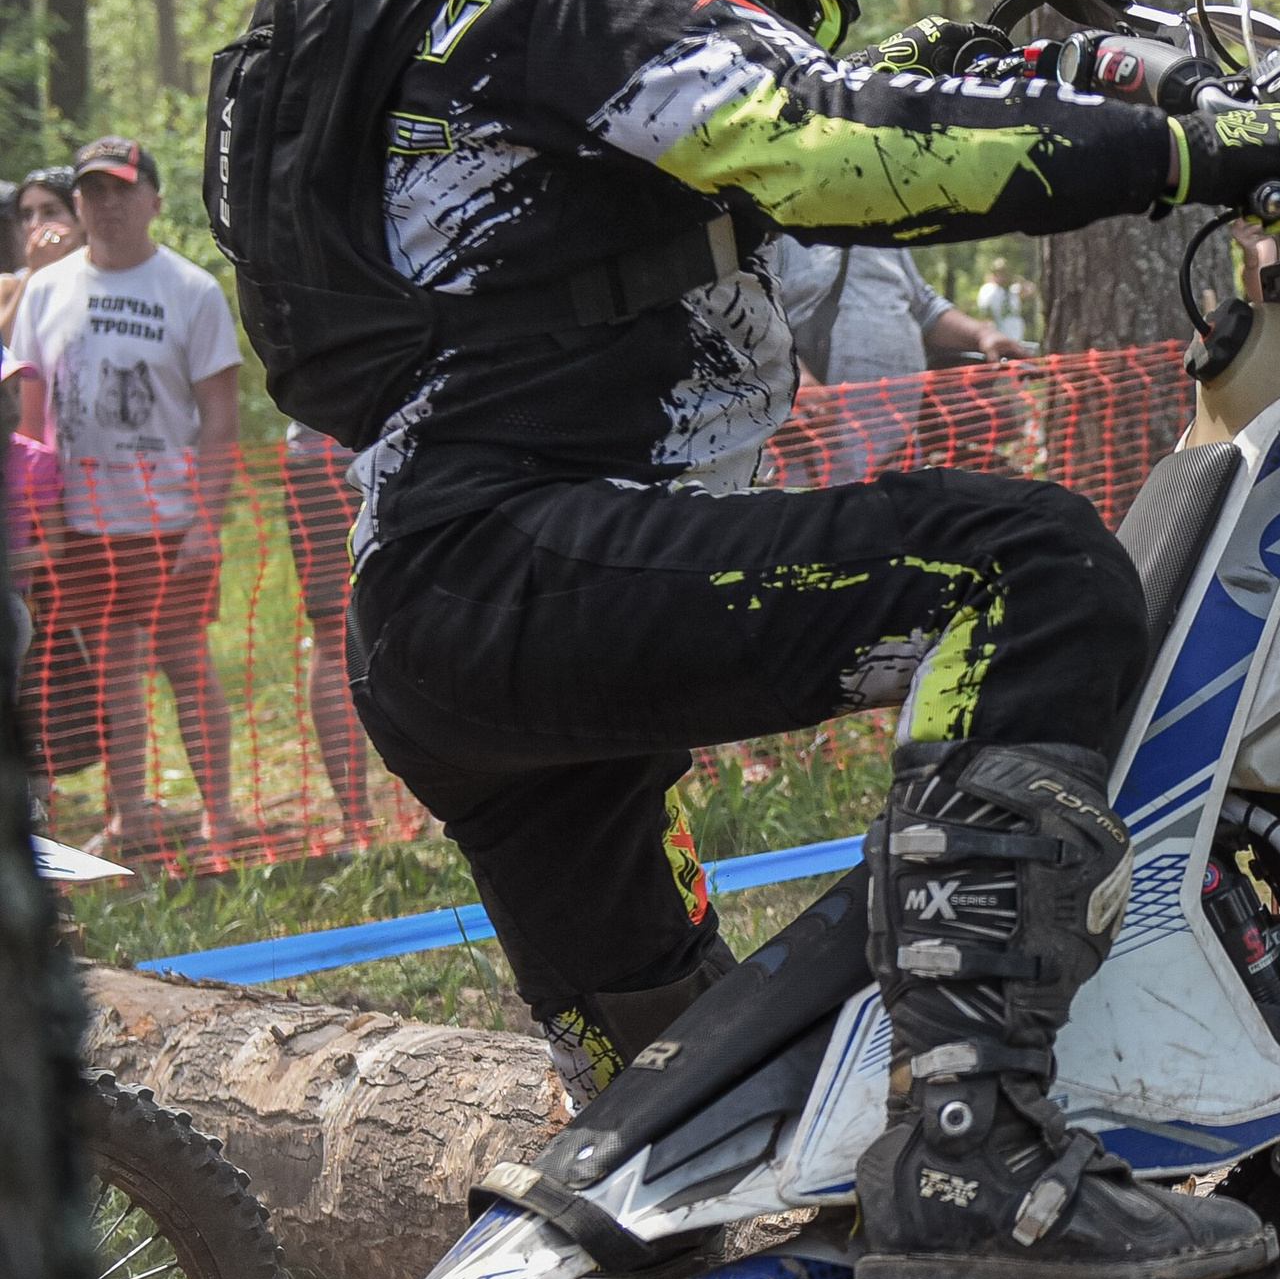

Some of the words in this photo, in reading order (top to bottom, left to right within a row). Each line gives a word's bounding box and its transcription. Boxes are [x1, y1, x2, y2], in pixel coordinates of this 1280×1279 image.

[219, 96, 236, 228] E-GEA
[89, 317, 165, 342] ТРОПЫ
[904, 879, 962, 920] MX
[949, 893, 998, 908] SERIES
